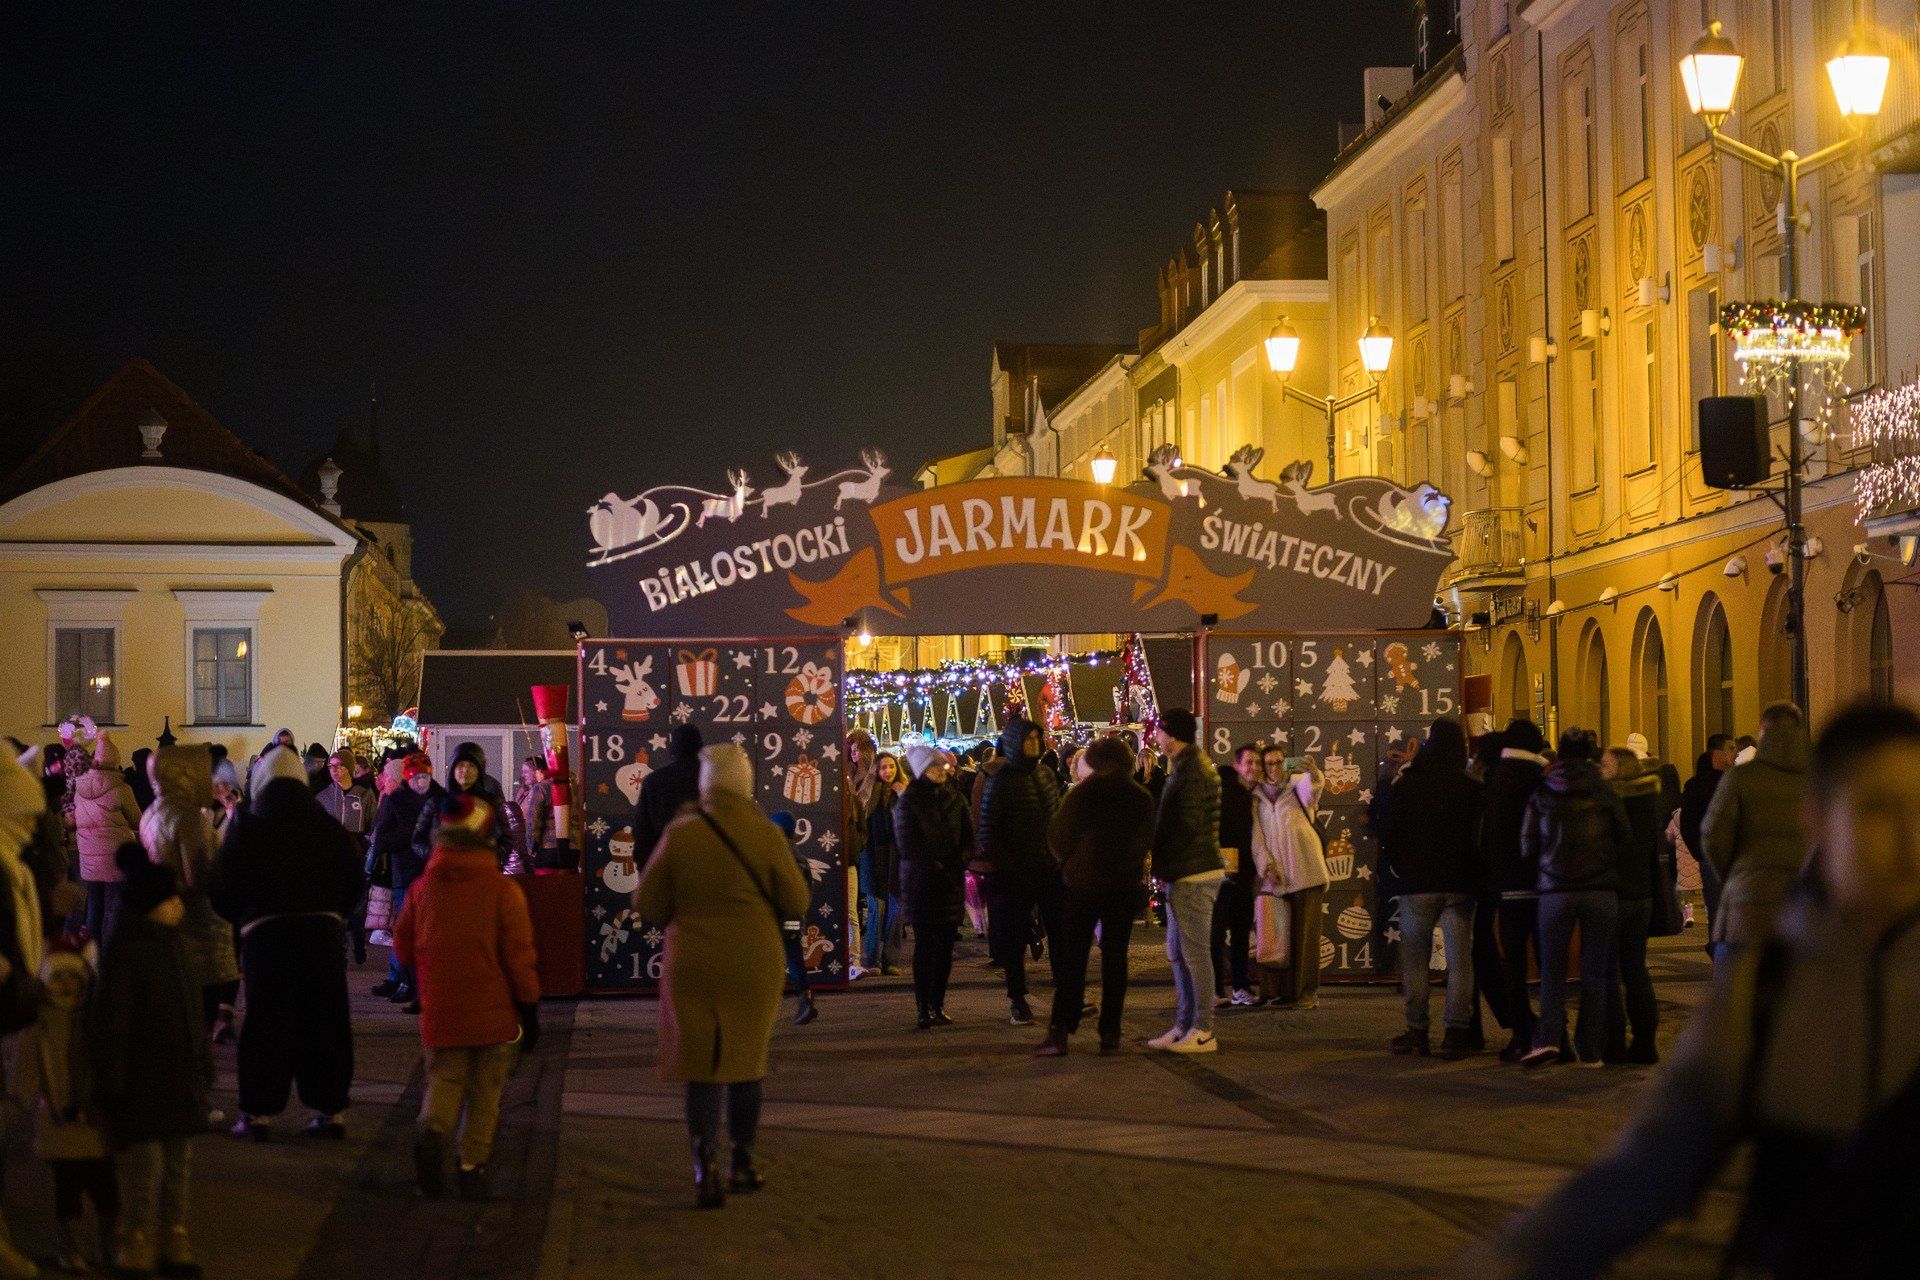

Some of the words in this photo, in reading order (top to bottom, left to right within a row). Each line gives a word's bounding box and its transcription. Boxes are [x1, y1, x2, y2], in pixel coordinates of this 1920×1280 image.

[895, 495, 1153, 565] JARMARK
[588, 648, 608, 676] 4
[764, 646, 800, 674] 12
[1250, 640, 1288, 669] 10
[1300, 640, 1318, 668] 5
[712, 694, 751, 722] 22
[1418, 687, 1453, 715] 15
[588, 734, 625, 762] 18
[763, 732, 783, 761] 9
[1213, 727, 1232, 755] 8
[1304, 725, 1322, 753] 2
[629, 951, 663, 979] 16
[1337, 941, 1374, 969] 14
